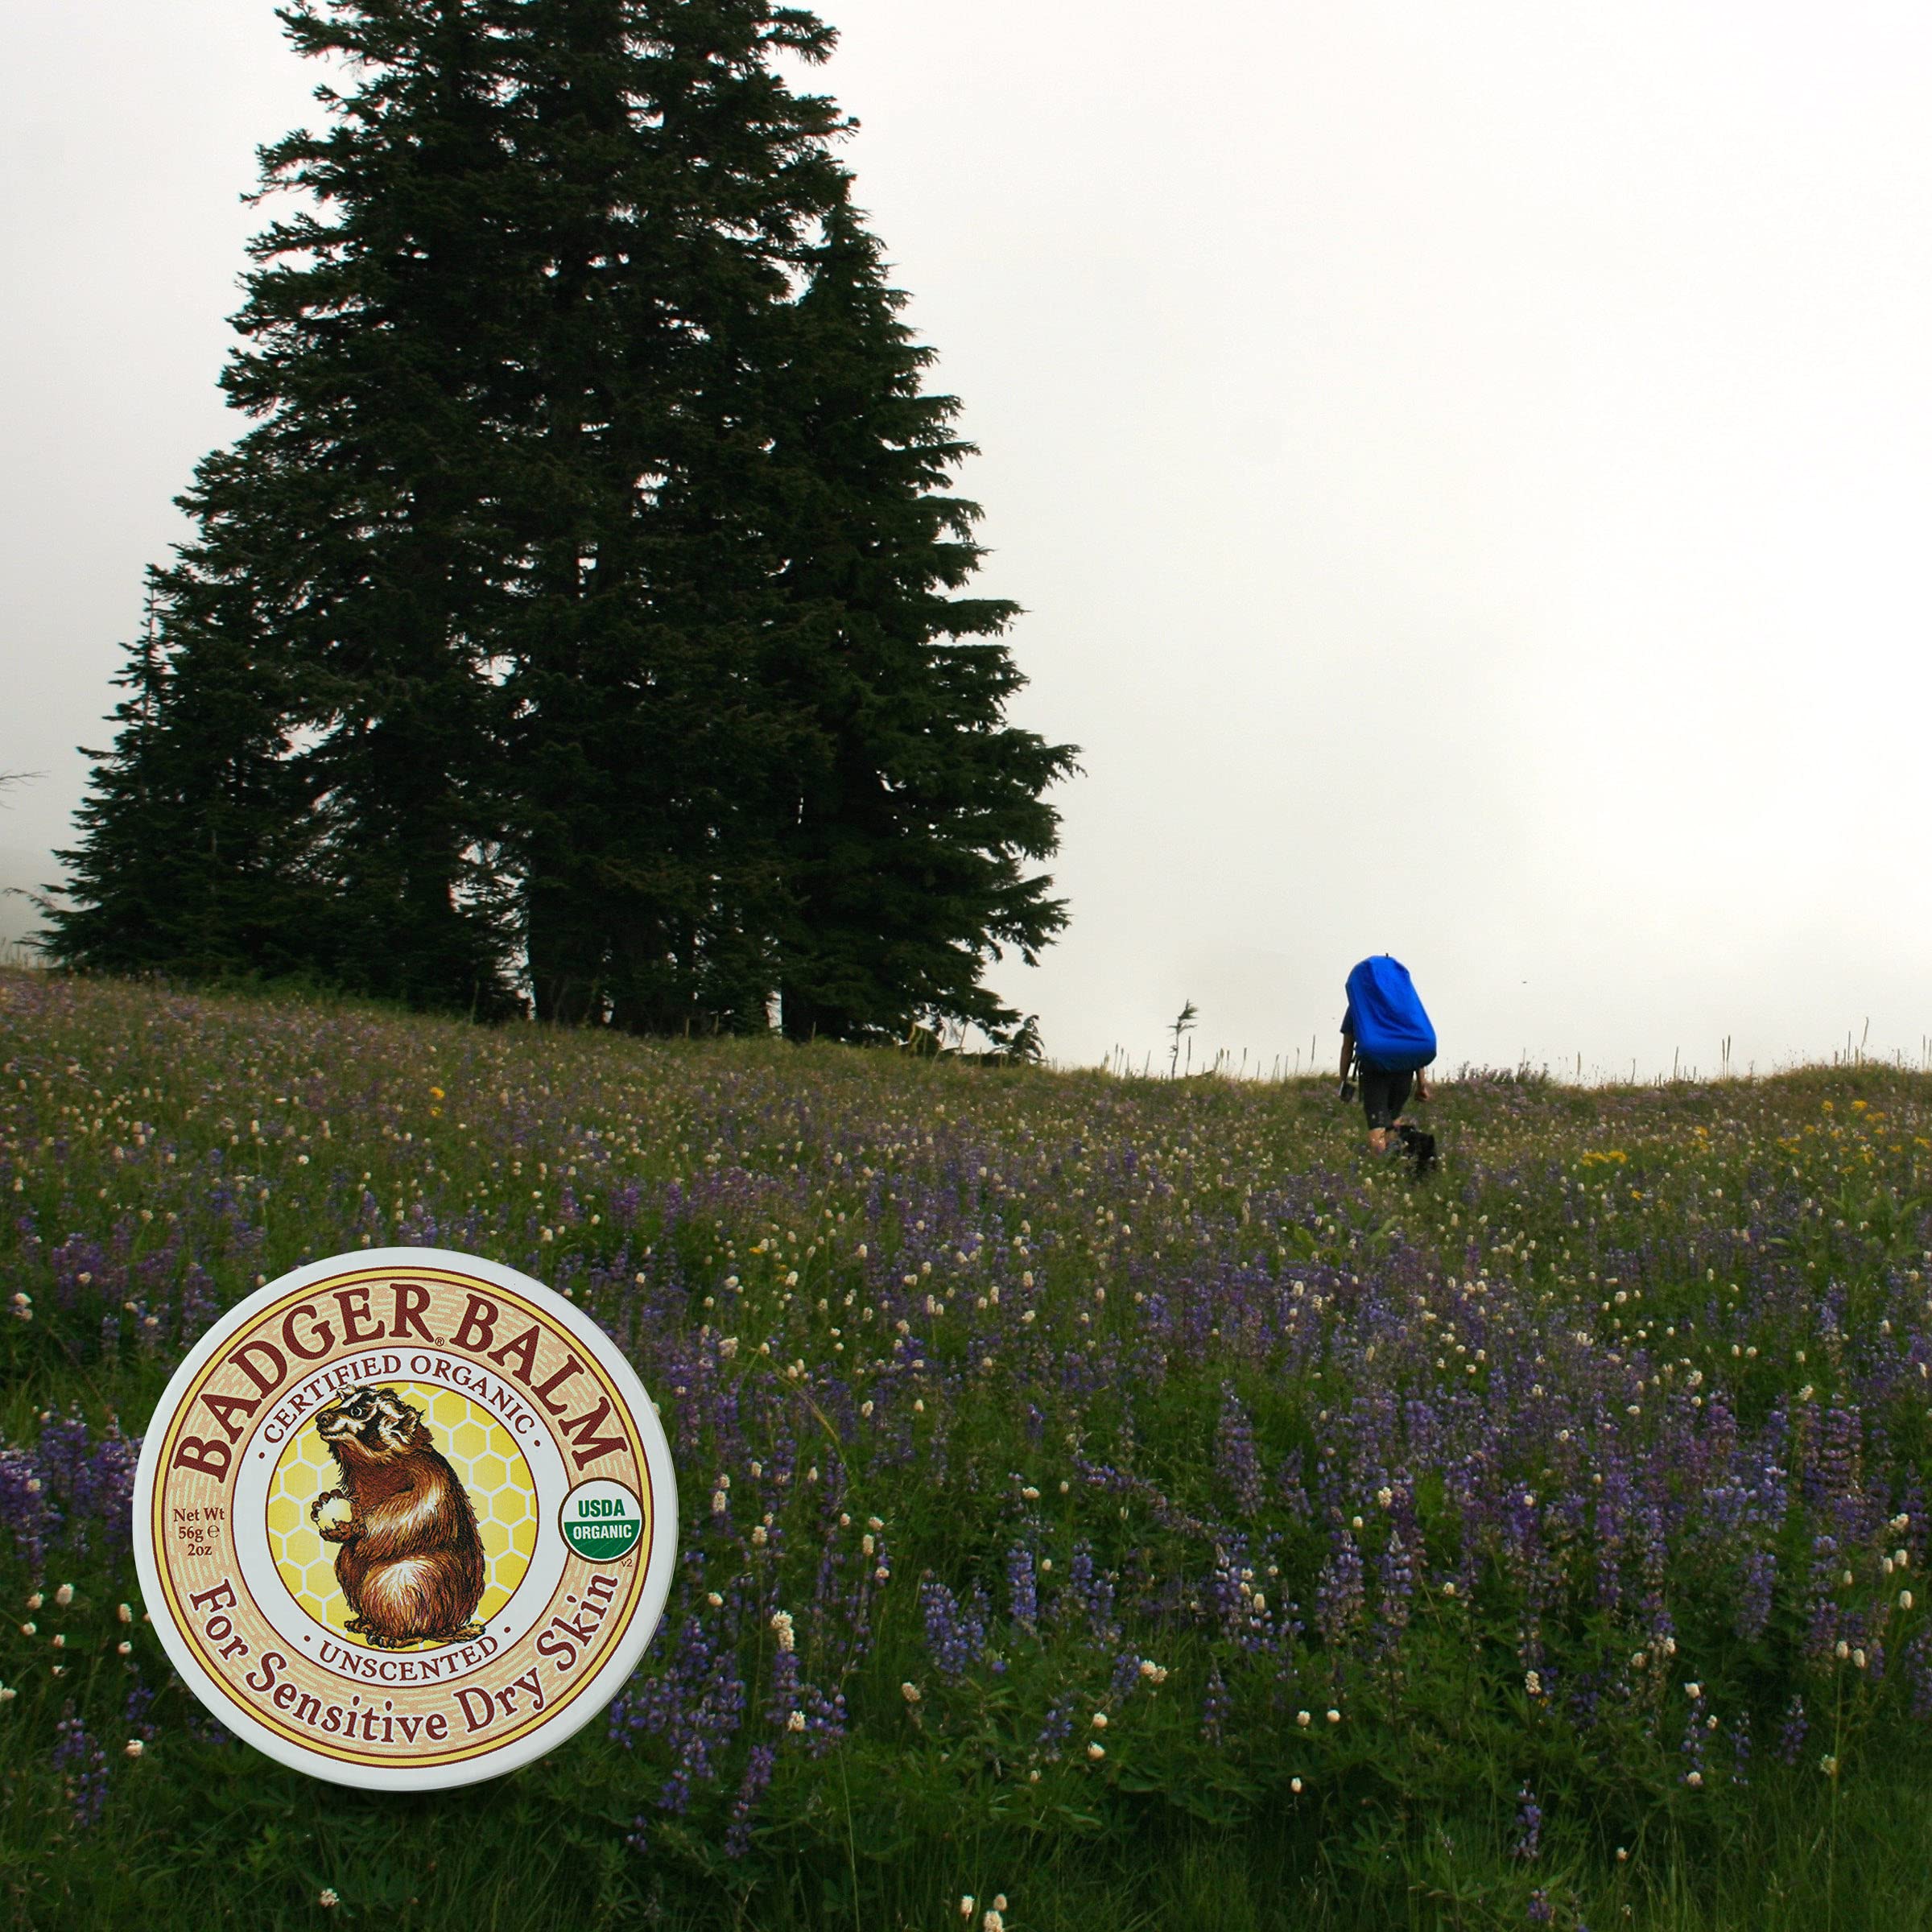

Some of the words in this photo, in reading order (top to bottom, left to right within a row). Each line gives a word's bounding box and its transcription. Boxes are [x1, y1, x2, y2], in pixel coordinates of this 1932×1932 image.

[449, 1293, 628, 1472] BALM
[263, 1354, 402, 1443] CERTIFIED
[410, 1355, 535, 1435] ORGANIC
[173, 1508, 200, 1522] Net
[203, 1507, 225, 1521] Wt
[578, 1499, 625, 1518] USDA
[178, 1525, 204, 1543] 56g
[572, 1524, 632, 1540] ORGANIC
[188, 1543, 213, 1556] 2oz
[621, 1558, 633, 1567] v2
[189, 1579, 249, 1661] For
[246, 1652, 448, 1743] Sensitive
[453, 1667, 544, 1732] Dry
[536, 1574, 618, 1671] Skin
[319, 1636, 498, 1682] UNSCENTED
